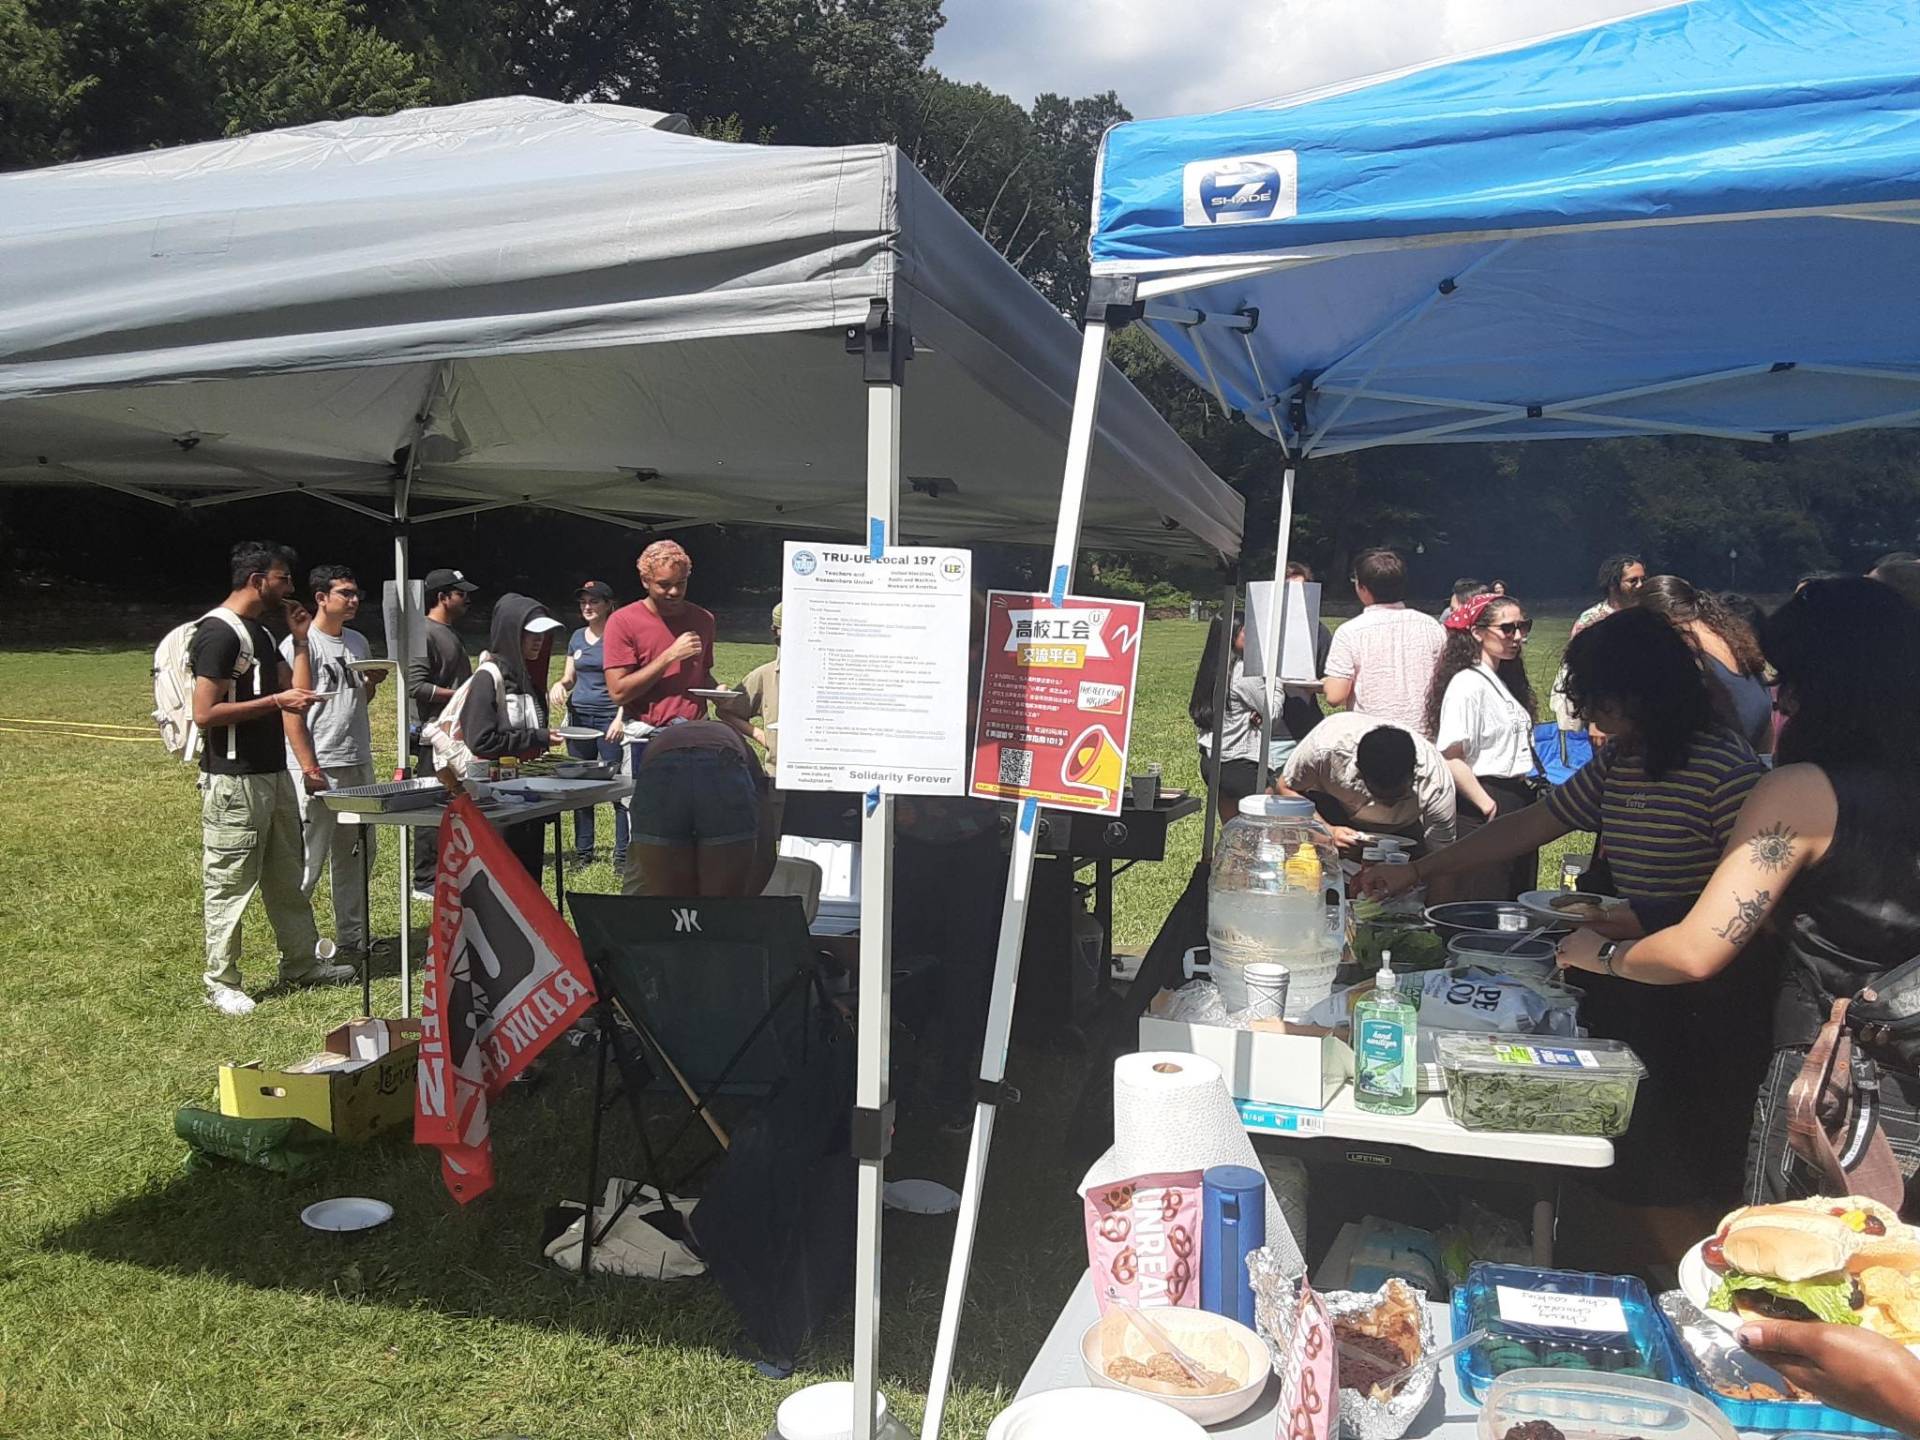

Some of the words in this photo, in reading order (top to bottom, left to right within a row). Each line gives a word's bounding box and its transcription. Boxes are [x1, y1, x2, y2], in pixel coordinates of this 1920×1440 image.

[1211, 192, 1272, 206] SHADE
[822, 552, 872, 565] TRU-UE
[914, 556, 937, 565] 197
[1093, 613, 1100, 623] U
[1016, 620, 1090, 640] 高校工会
[1023, 647, 1078, 664] 交流平台
[849, 770, 903, 783] Solidarity
[907, 774, 952, 784] Forever
[1372, 1030, 1393, 1040] hand
